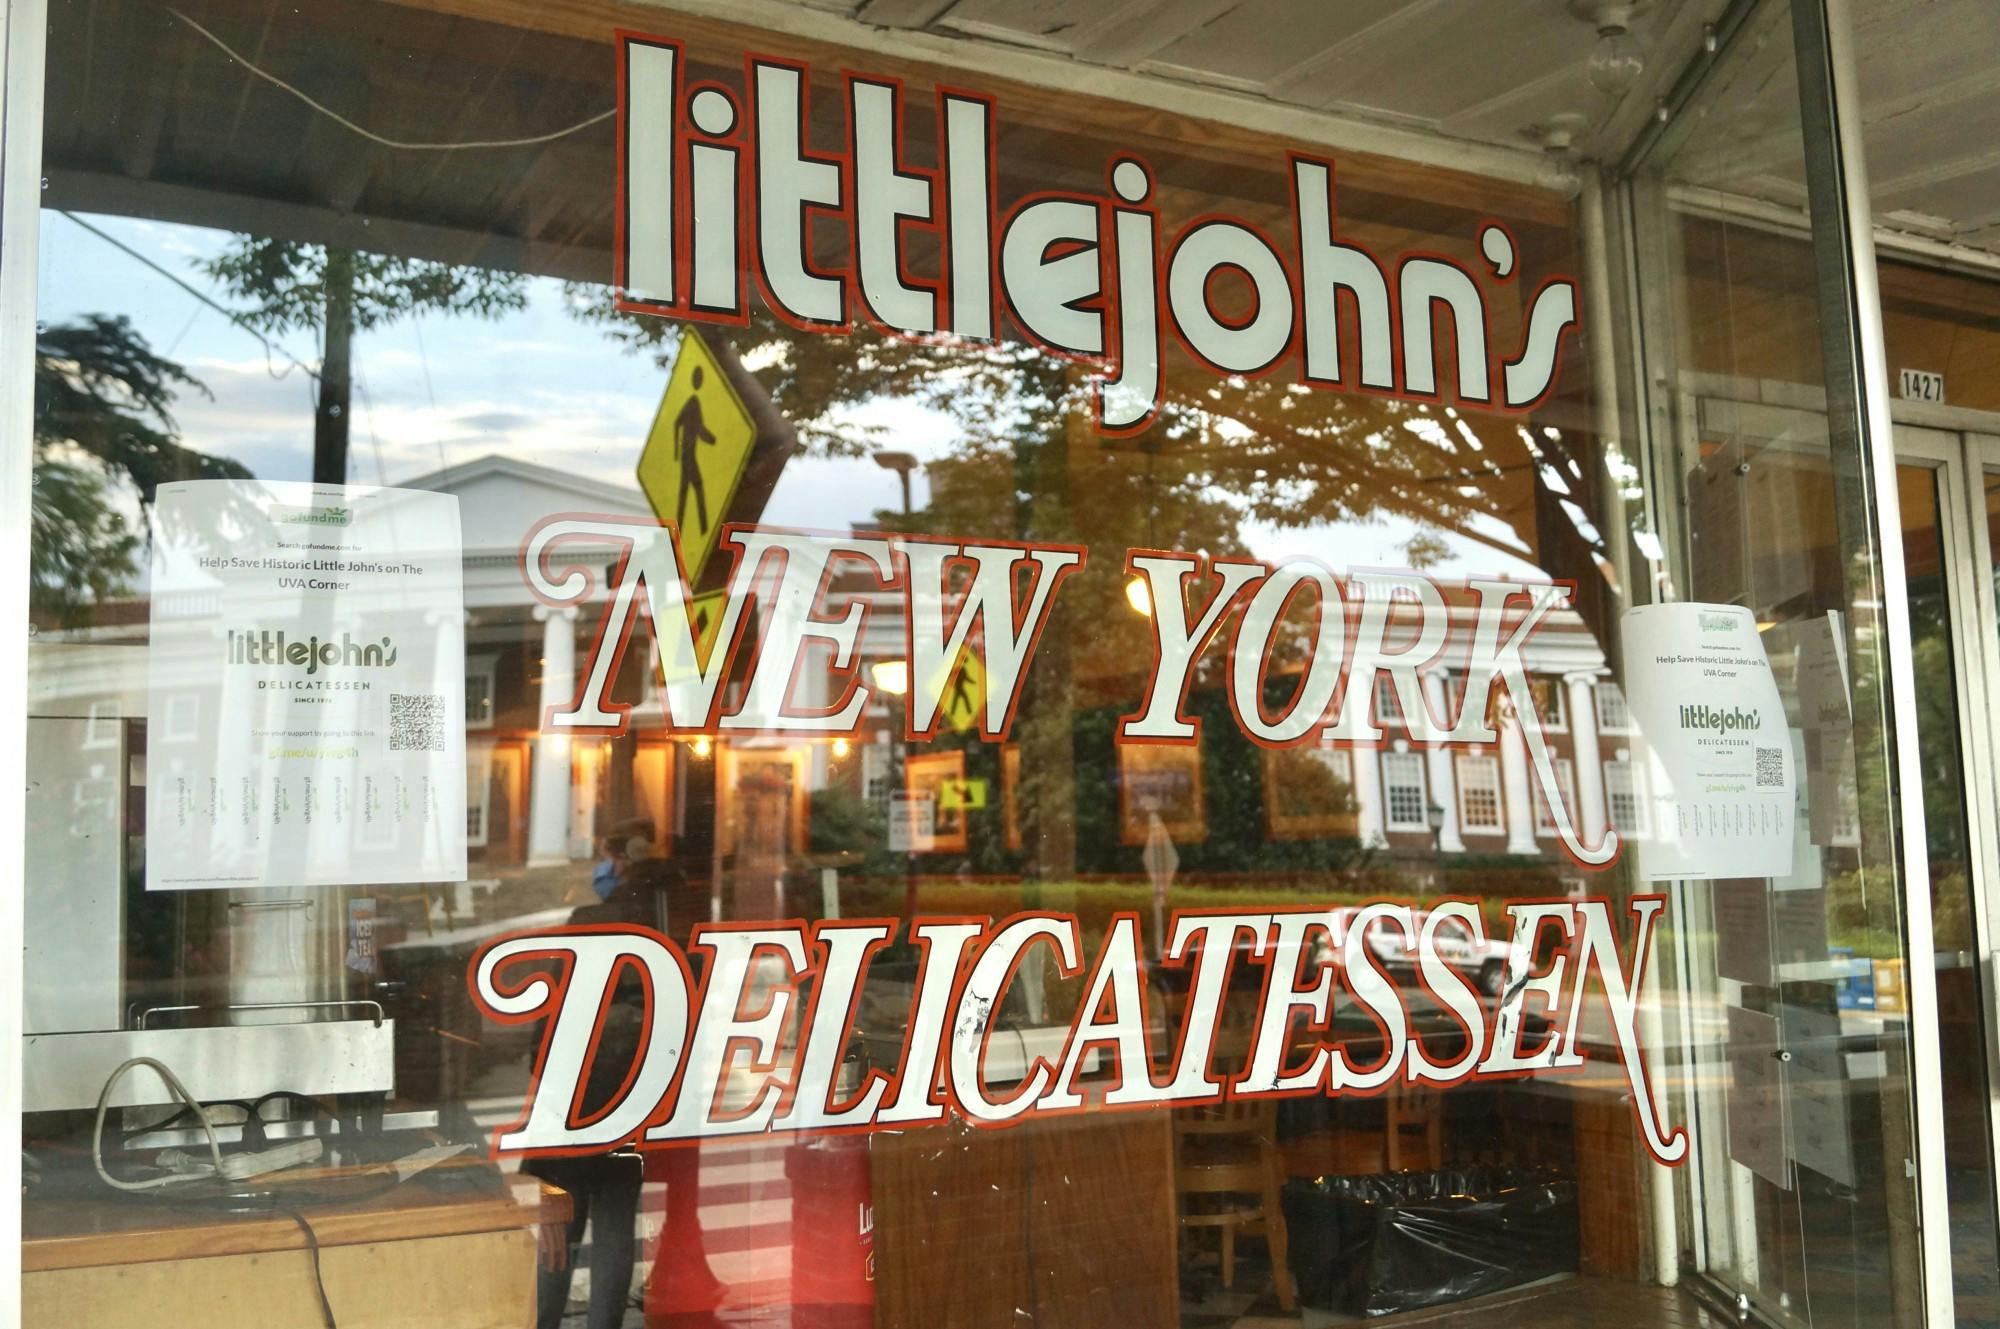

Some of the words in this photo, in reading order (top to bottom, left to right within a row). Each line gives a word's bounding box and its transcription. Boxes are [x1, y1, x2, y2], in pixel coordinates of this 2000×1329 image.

[614, 30, 1581, 436] littlejohn's
[1904, 372, 1941, 402] 1427
[199, 557, 229, 570] Help
[231, 557, 260, 569] Save
[263, 557, 311, 571] Historic
[313, 560, 345, 572] Little
[347, 561, 383, 573] John's
[386, 564, 400, 575] on
[402, 564, 423, 576] The
[278, 577, 306, 589] UVA
[308, 578, 351, 591] Corner
[228, 629, 397, 675] littlejohn's
[1656, 656, 1676, 665] Help
[1677, 655, 1694, 663] Save
[1695, 655, 1717, 664] Historic
[1719, 656, 1733, 665] Little
[258, 680, 371, 690] DELICATESSEN
[1704, 669, 1716, 678] UVA
[1718, 670, 1737, 678] Corner
[519, 512, 1087, 743] NEW
[1115, 550, 1622, 870] YORK
[1679, 705, 1760, 735] littlejohn's
[1697, 738, 1749, 746] DELICATESSEN
[467, 892, 1689, 1167] DELICATESSEN
